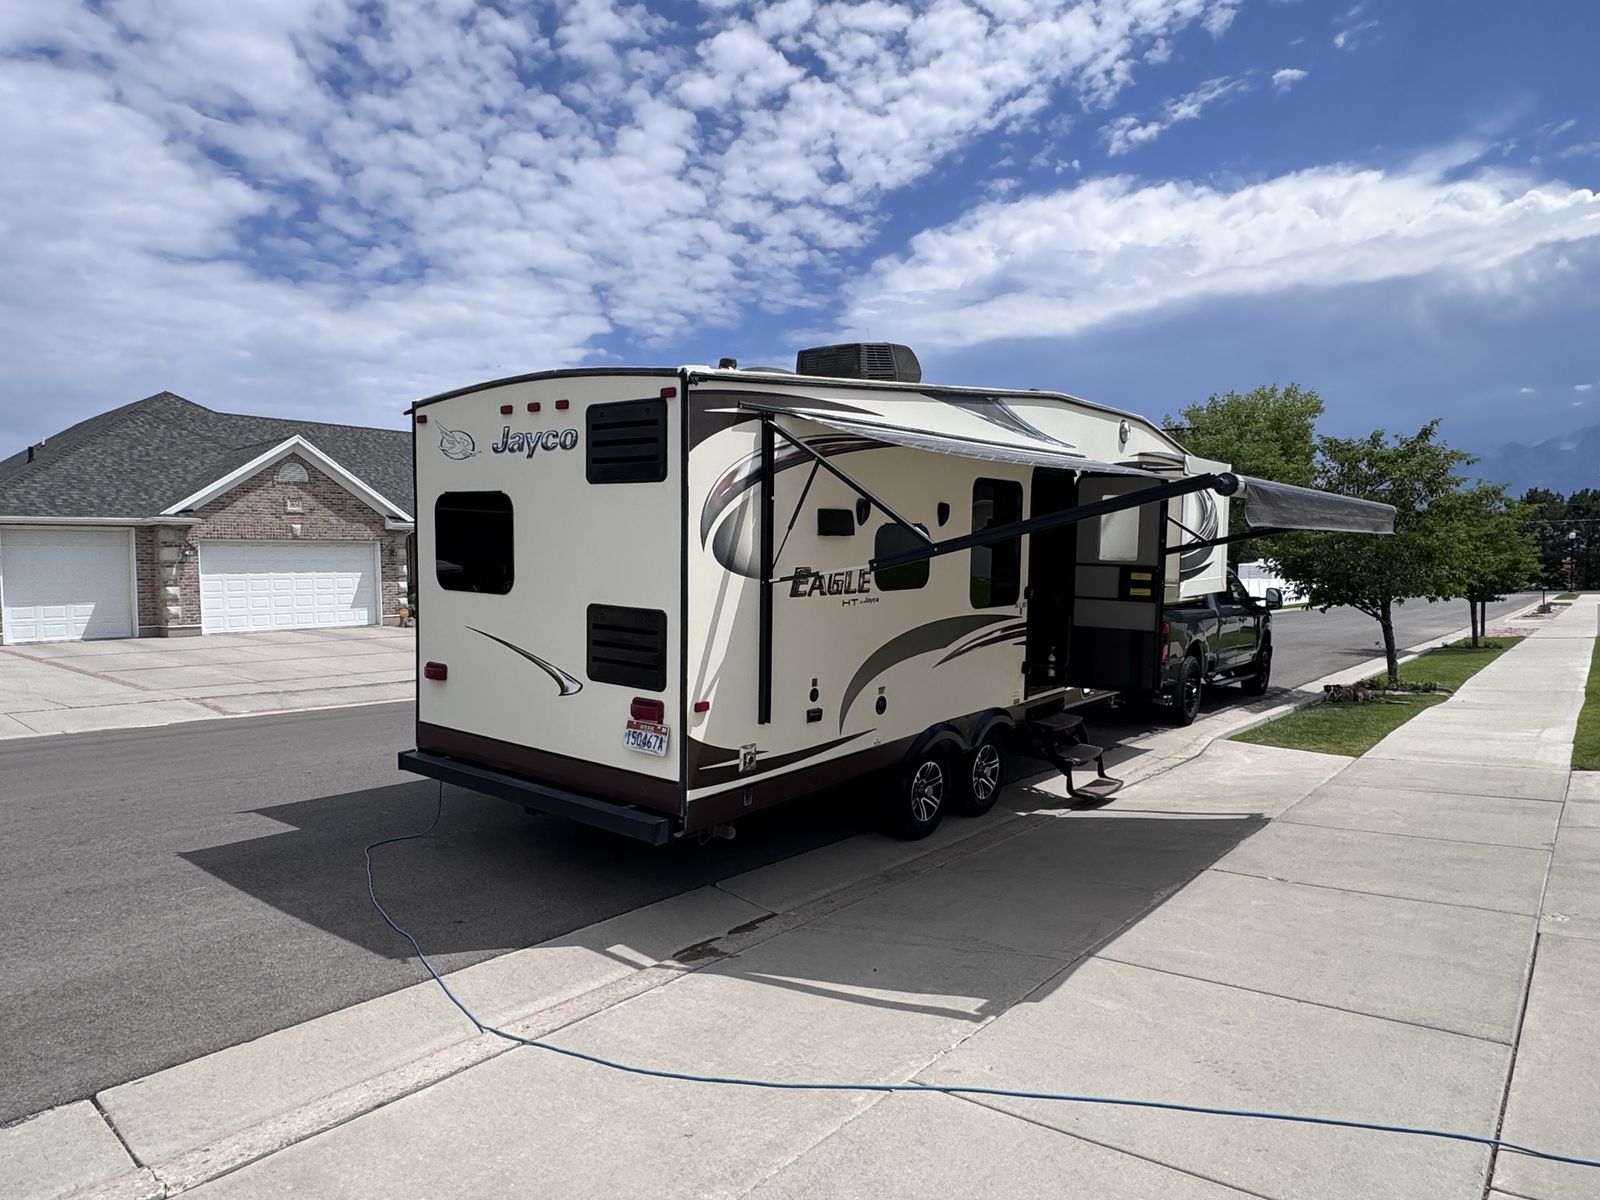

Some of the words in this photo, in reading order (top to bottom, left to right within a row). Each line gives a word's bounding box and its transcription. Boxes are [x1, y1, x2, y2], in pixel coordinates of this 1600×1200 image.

[492, 426, 578, 458] Jayco
[789, 566, 872, 598] EAGLE
[842, 598, 859, 607] HT
